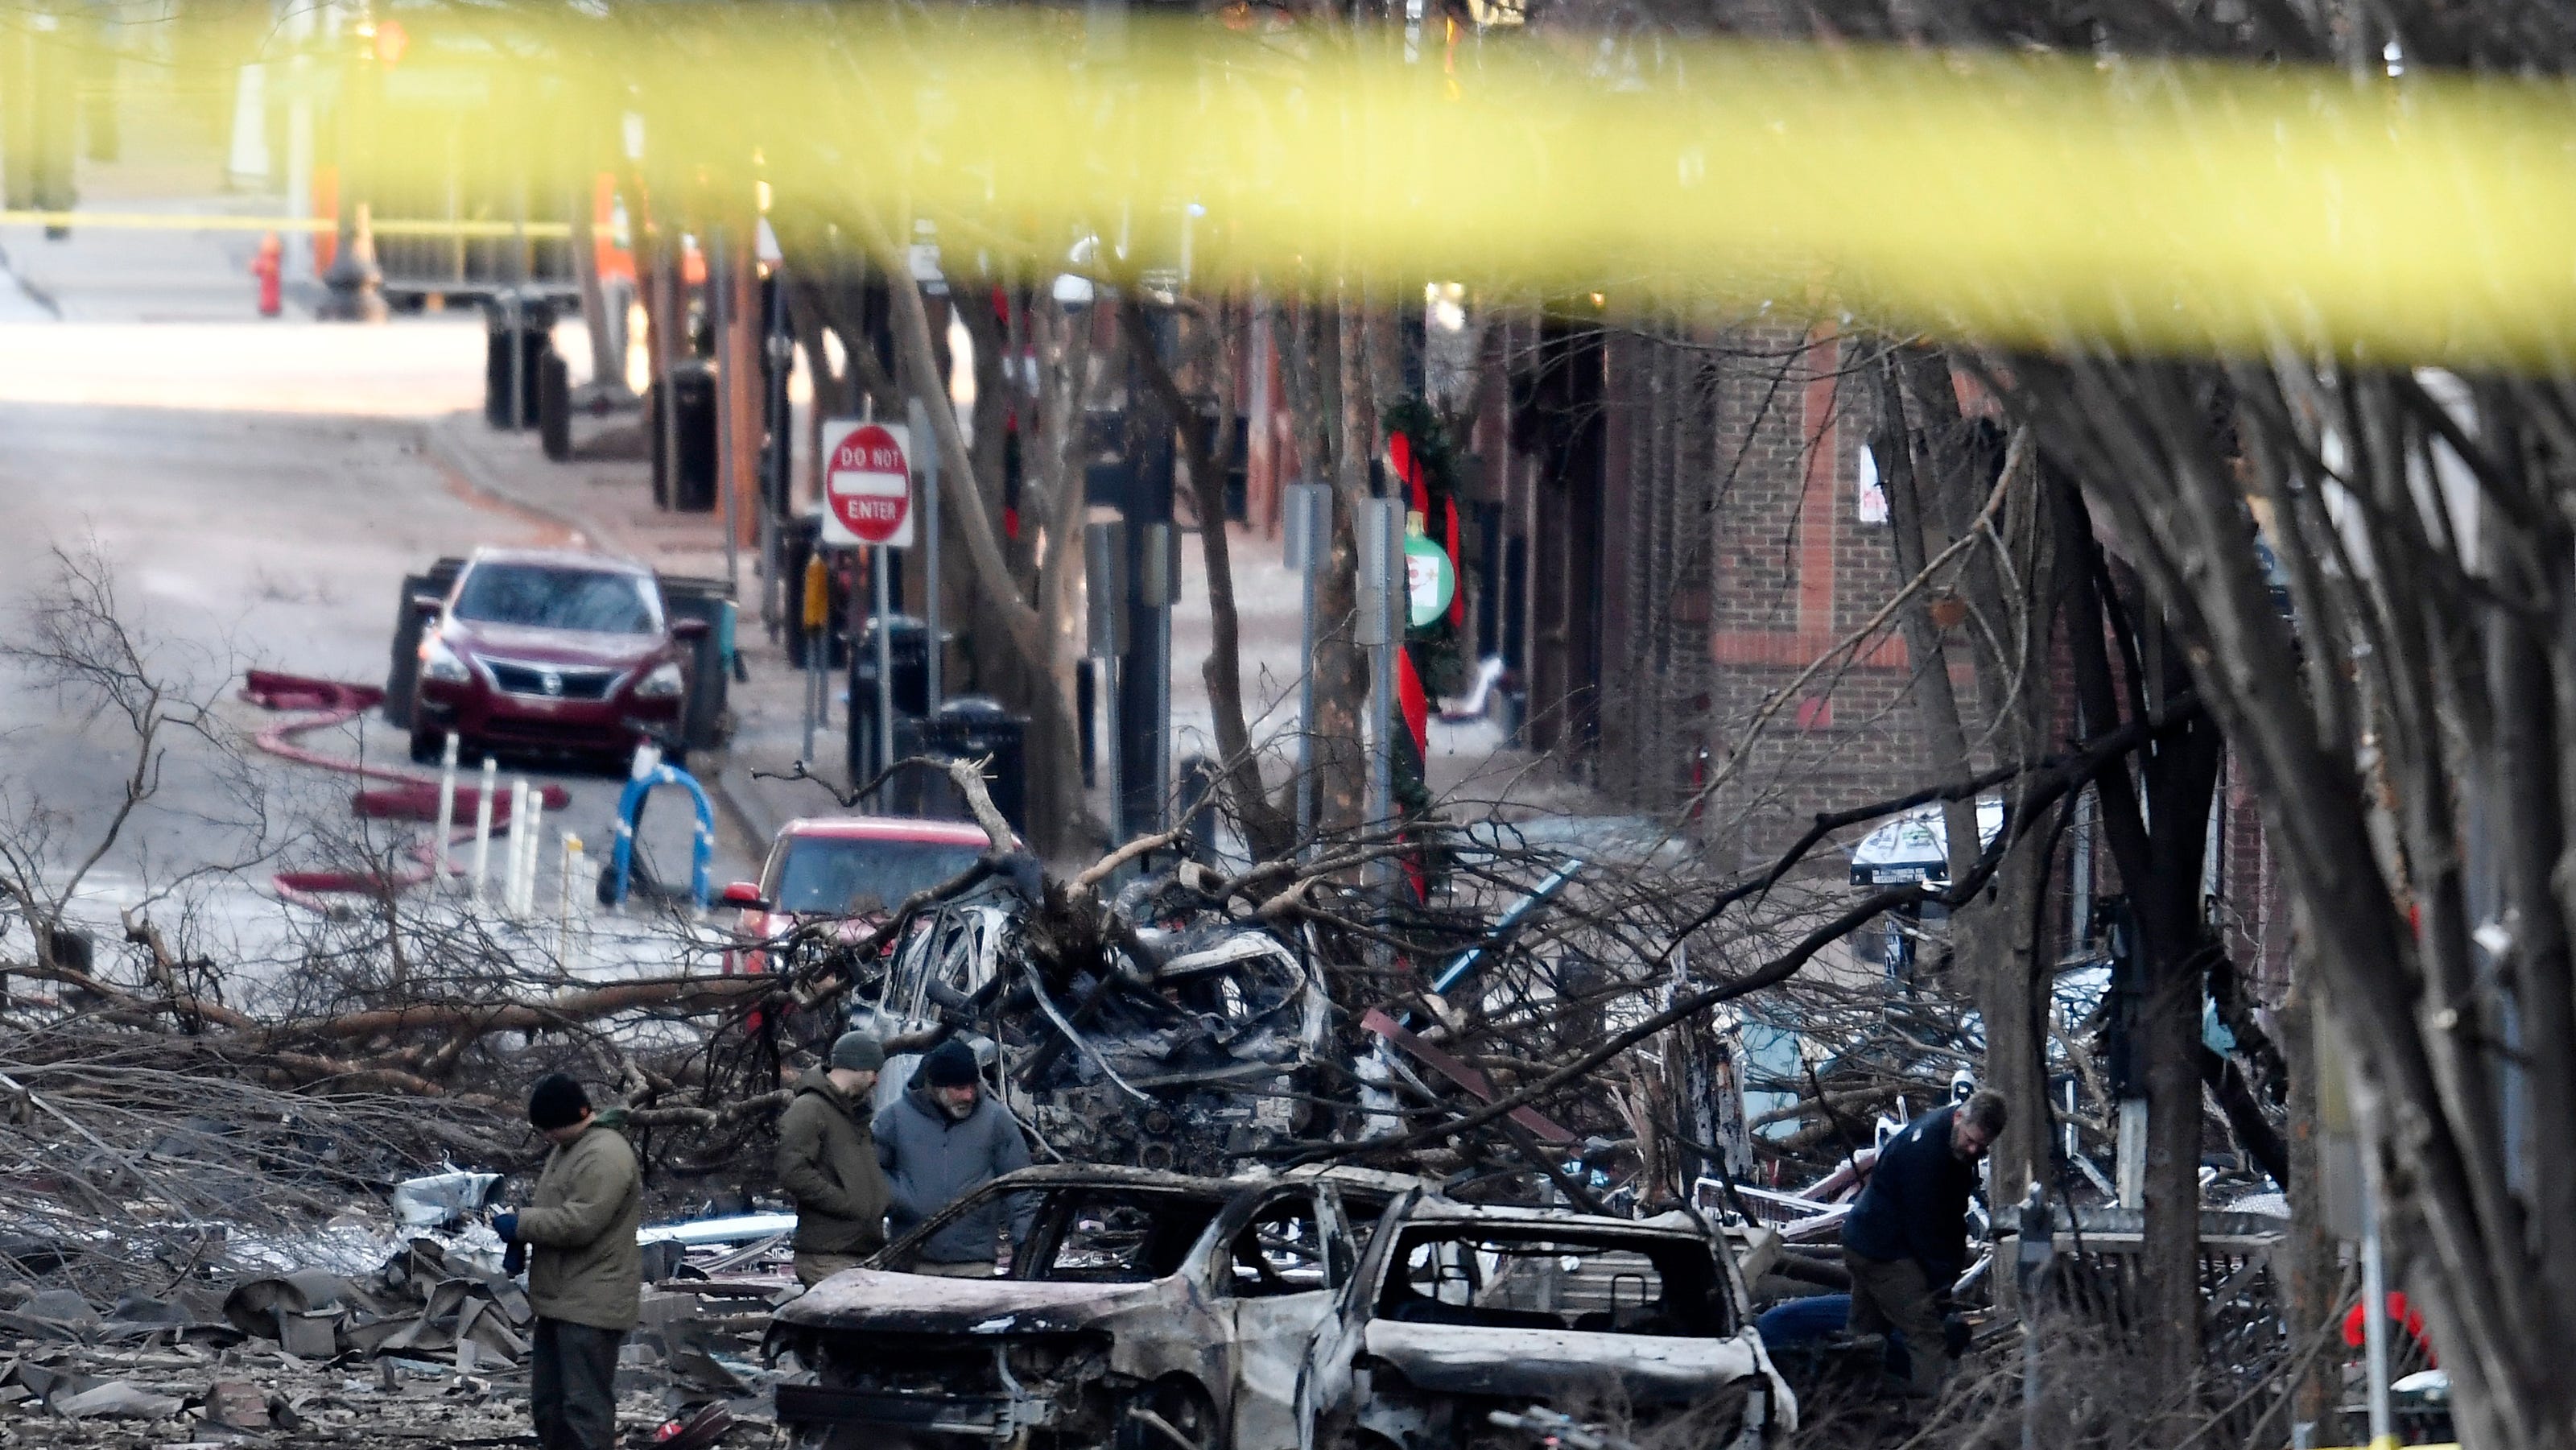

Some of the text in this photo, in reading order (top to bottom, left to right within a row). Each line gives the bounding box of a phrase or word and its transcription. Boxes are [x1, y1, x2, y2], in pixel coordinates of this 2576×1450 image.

[841, 447, 898, 468] DO NOT
[848, 500, 896, 520] ENTER
